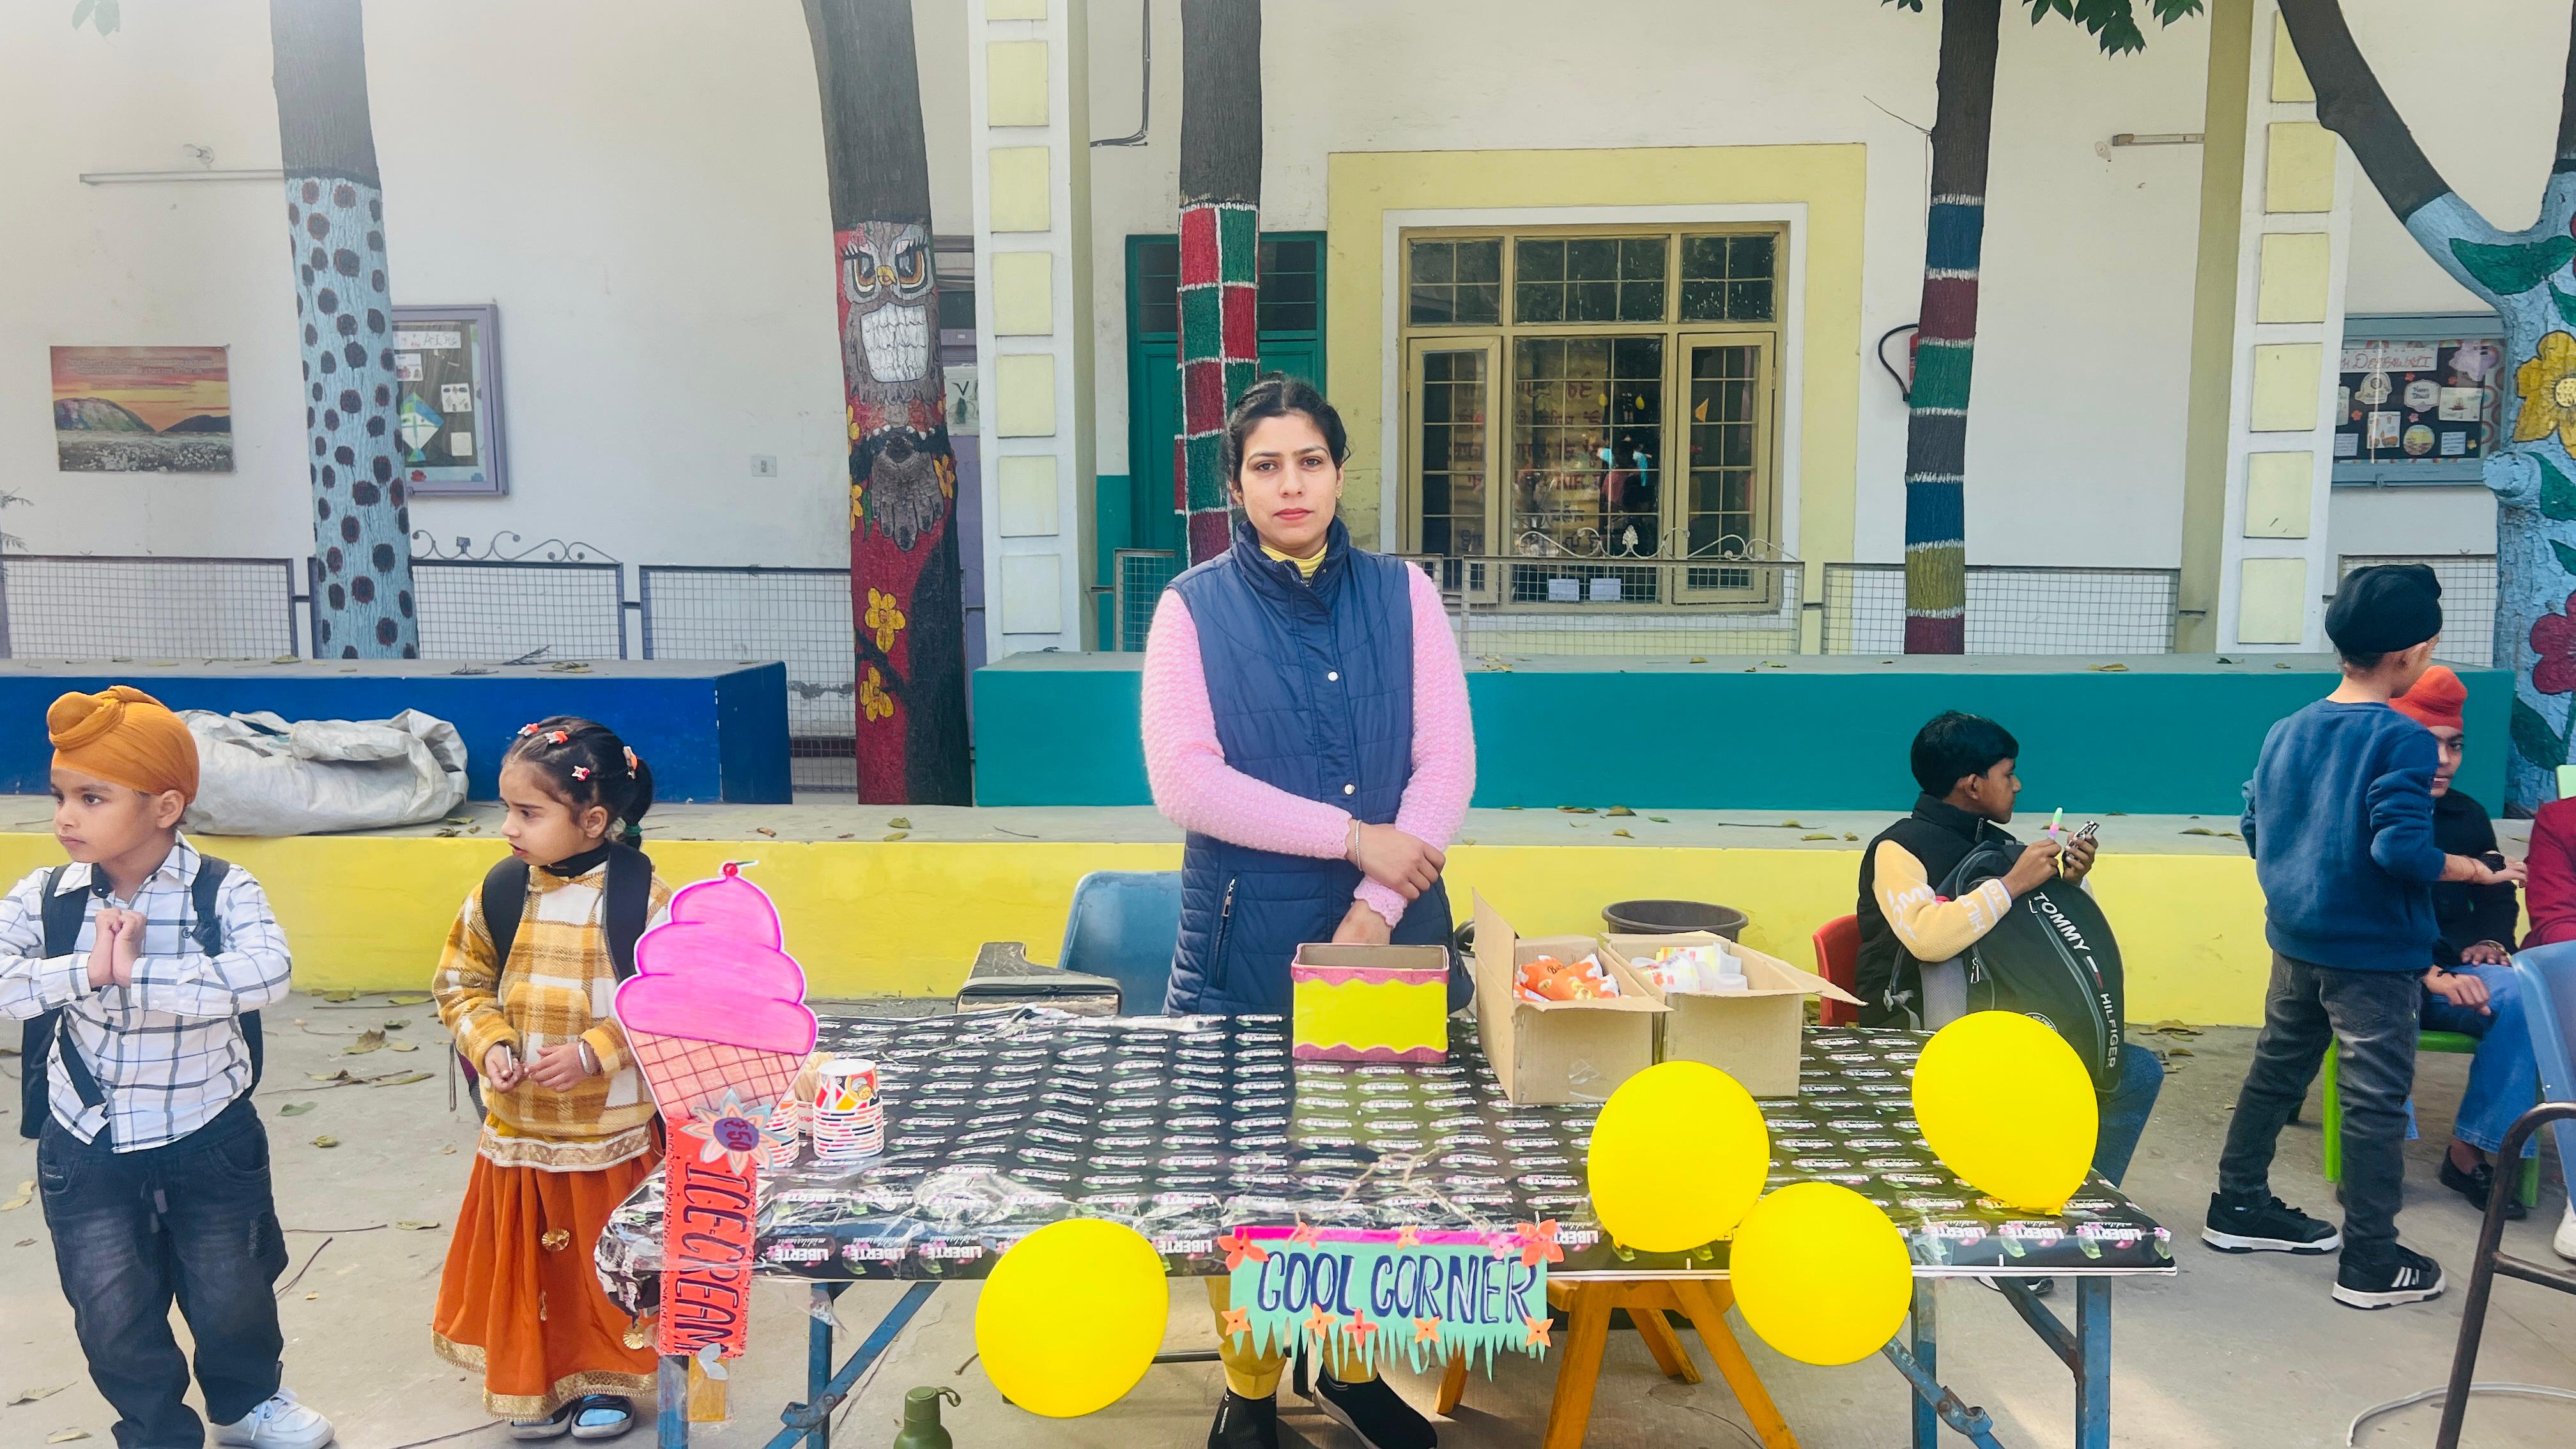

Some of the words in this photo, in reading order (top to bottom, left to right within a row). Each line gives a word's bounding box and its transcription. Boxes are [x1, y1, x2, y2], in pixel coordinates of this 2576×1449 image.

[2034, 892, 2090, 951] TOMMY
[2101, 993, 2119, 1068] HILFIGER
[1555, 1229, 1599, 1244] LIBERT
[774, 1245, 829, 1262] LIBERTÉ
[851, 1246, 905, 1262] LIBERTÉ
[928, 1245, 983, 1261] LIBERTÉ
[1158, 1238, 1213, 1254] LIBERTÉ
[1258, 1251, 1363, 1316] COOL
[1371, 1254, 1537, 1326] CORNER
